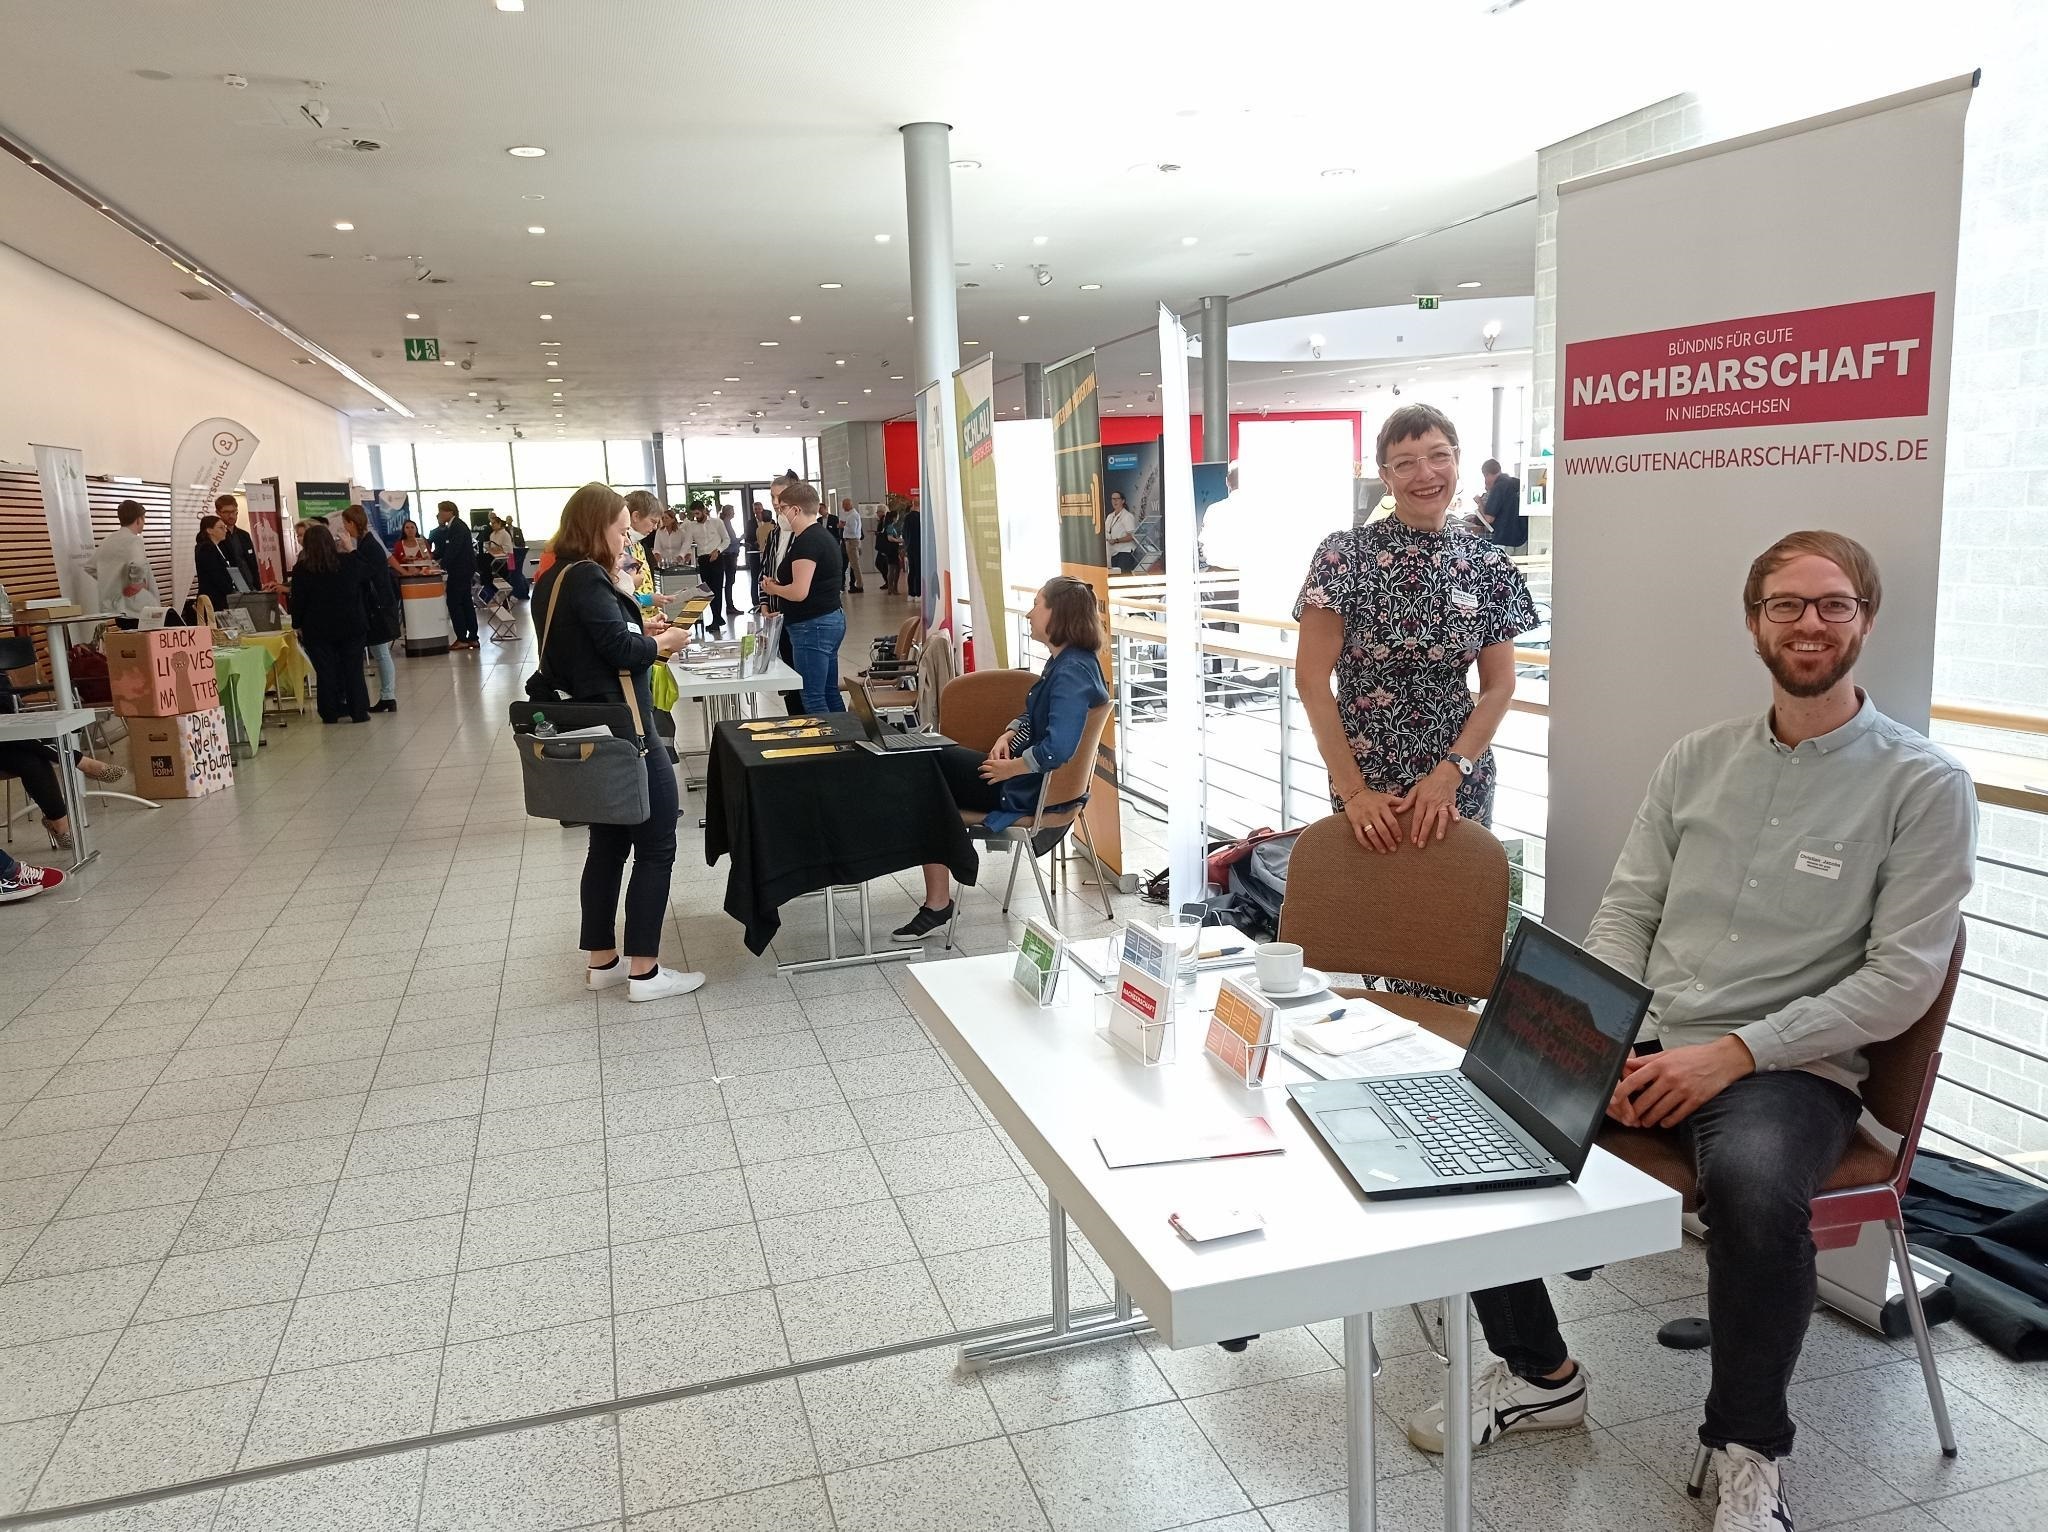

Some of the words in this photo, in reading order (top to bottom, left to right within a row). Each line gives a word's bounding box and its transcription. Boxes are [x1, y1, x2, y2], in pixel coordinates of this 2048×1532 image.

[1668, 336, 1724, 356] BÜNDNIS
[1726, 329, 1752, 349] FÜR
[1754, 327, 1793, 345] GUTE
[1572, 338, 1920, 407] NACHBARSCHAFT
[1665, 407, 1680, 421] IN
[1682, 397, 1790, 420] NIEDERSACHSEN
[963, 406, 990, 453] SCHLAU
[1564, 438, 1929, 477] WWW.GUTENACHBARSCHAFT-NDS.DE
[196, 460, 230, 521] Opferschutz
[159, 629, 196, 649] BLACK
[192, 713, 210, 732] Die
[189, 731, 217, 760] Welt
[153, 768, 174, 776] FORM
[192, 758, 207, 777] ist
